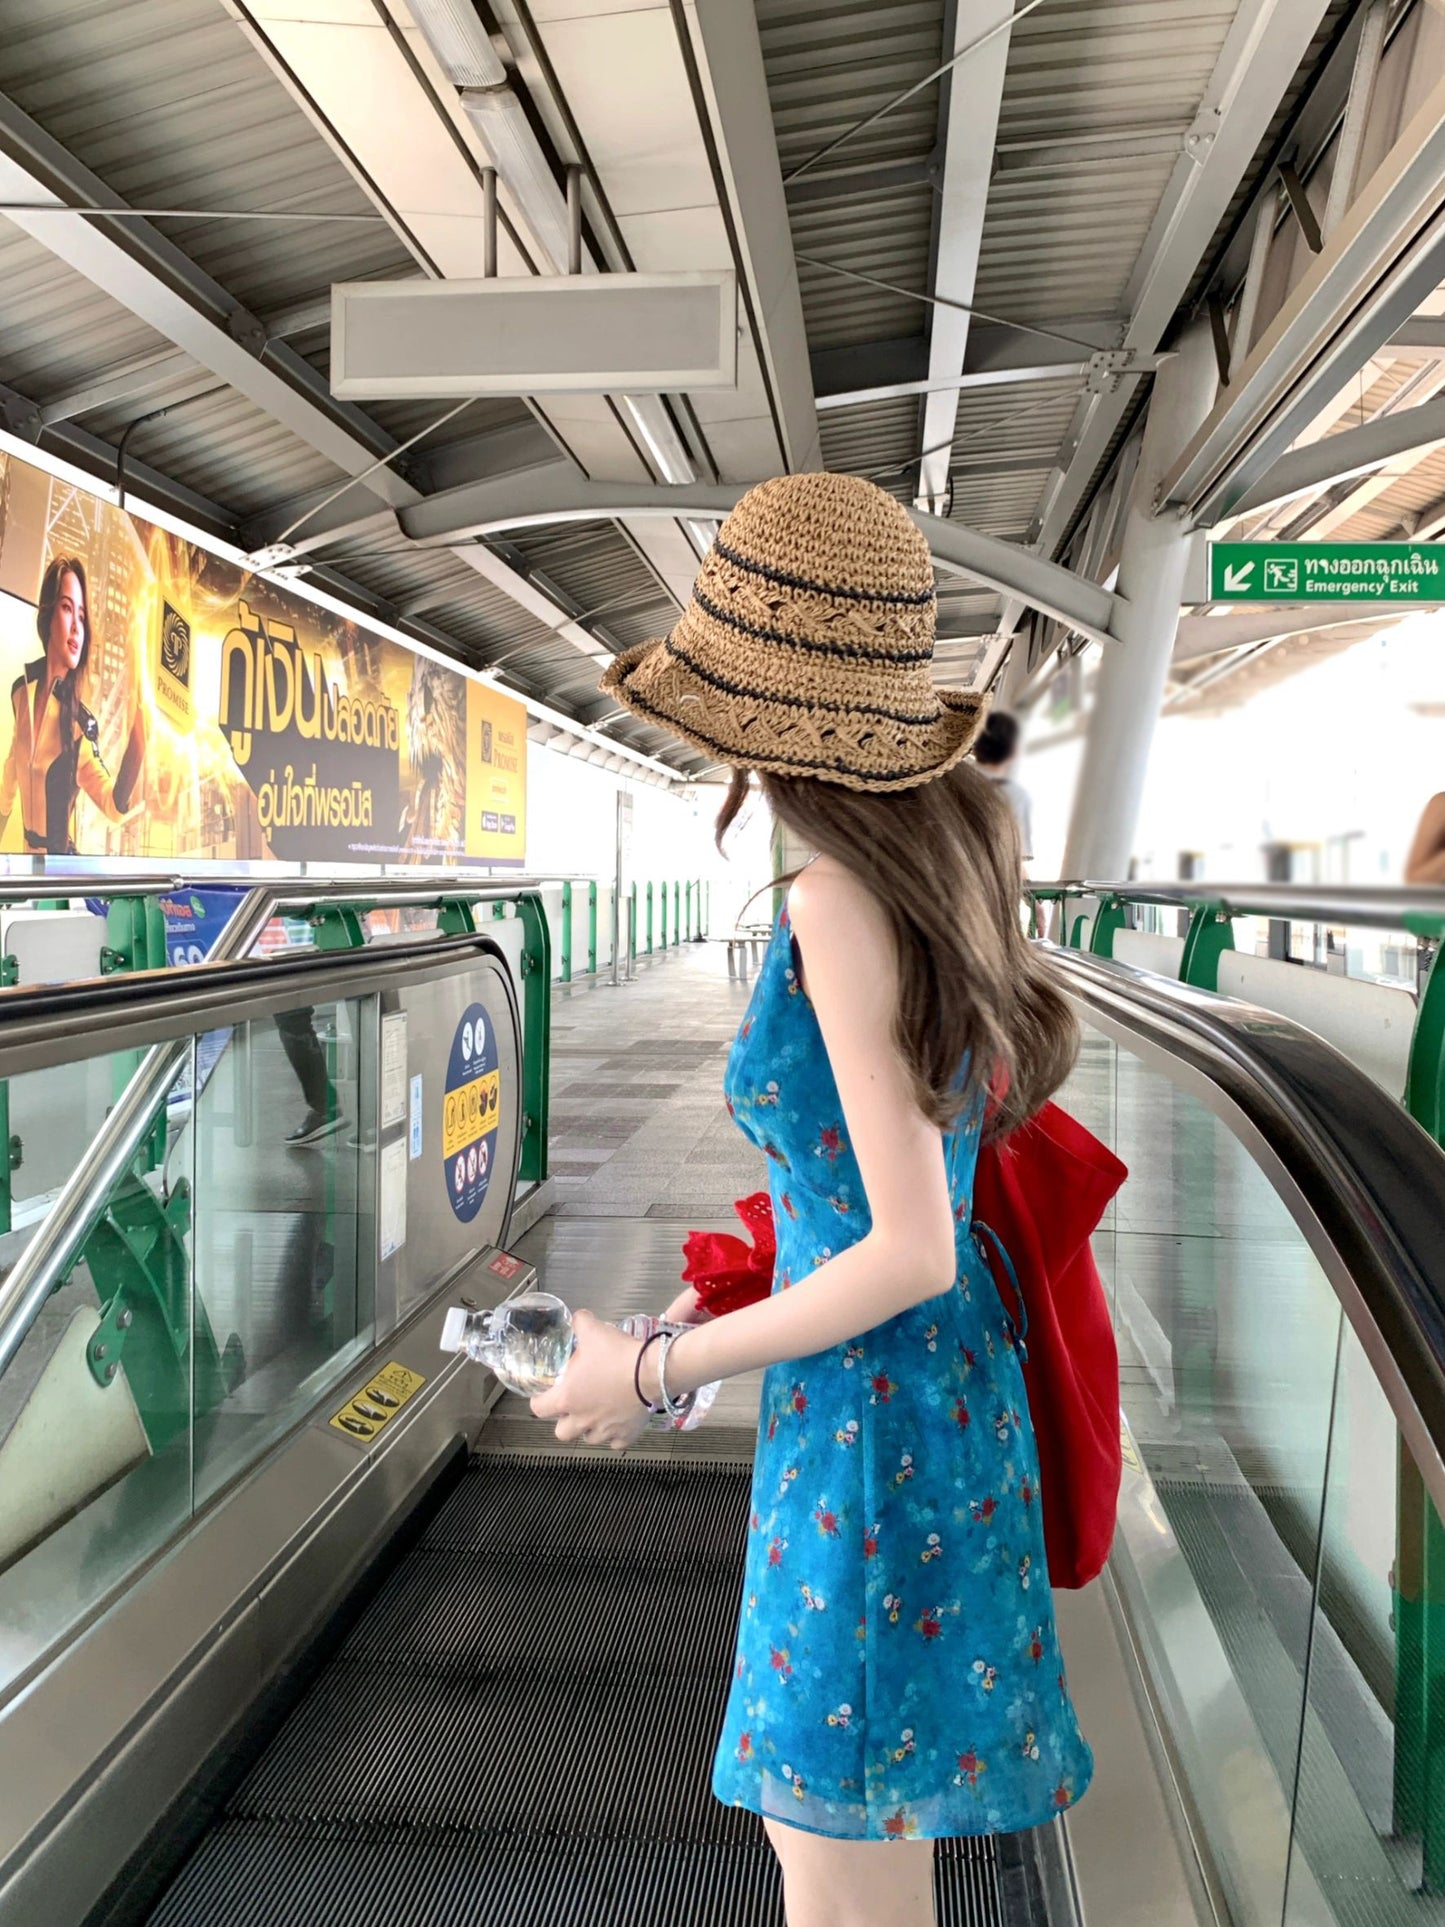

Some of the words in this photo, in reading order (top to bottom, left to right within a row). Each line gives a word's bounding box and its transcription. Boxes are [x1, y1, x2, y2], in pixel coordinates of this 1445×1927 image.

[1304, 552, 1439, 584] ทางออกฉุกเฉิน
[1305, 579, 1384, 596] Emergency
[1390, 579, 1419, 593] Exit
[156, 676, 190, 716] PROMISE
[257, 762, 373, 843] อุ่นใจที่พรอมิส
